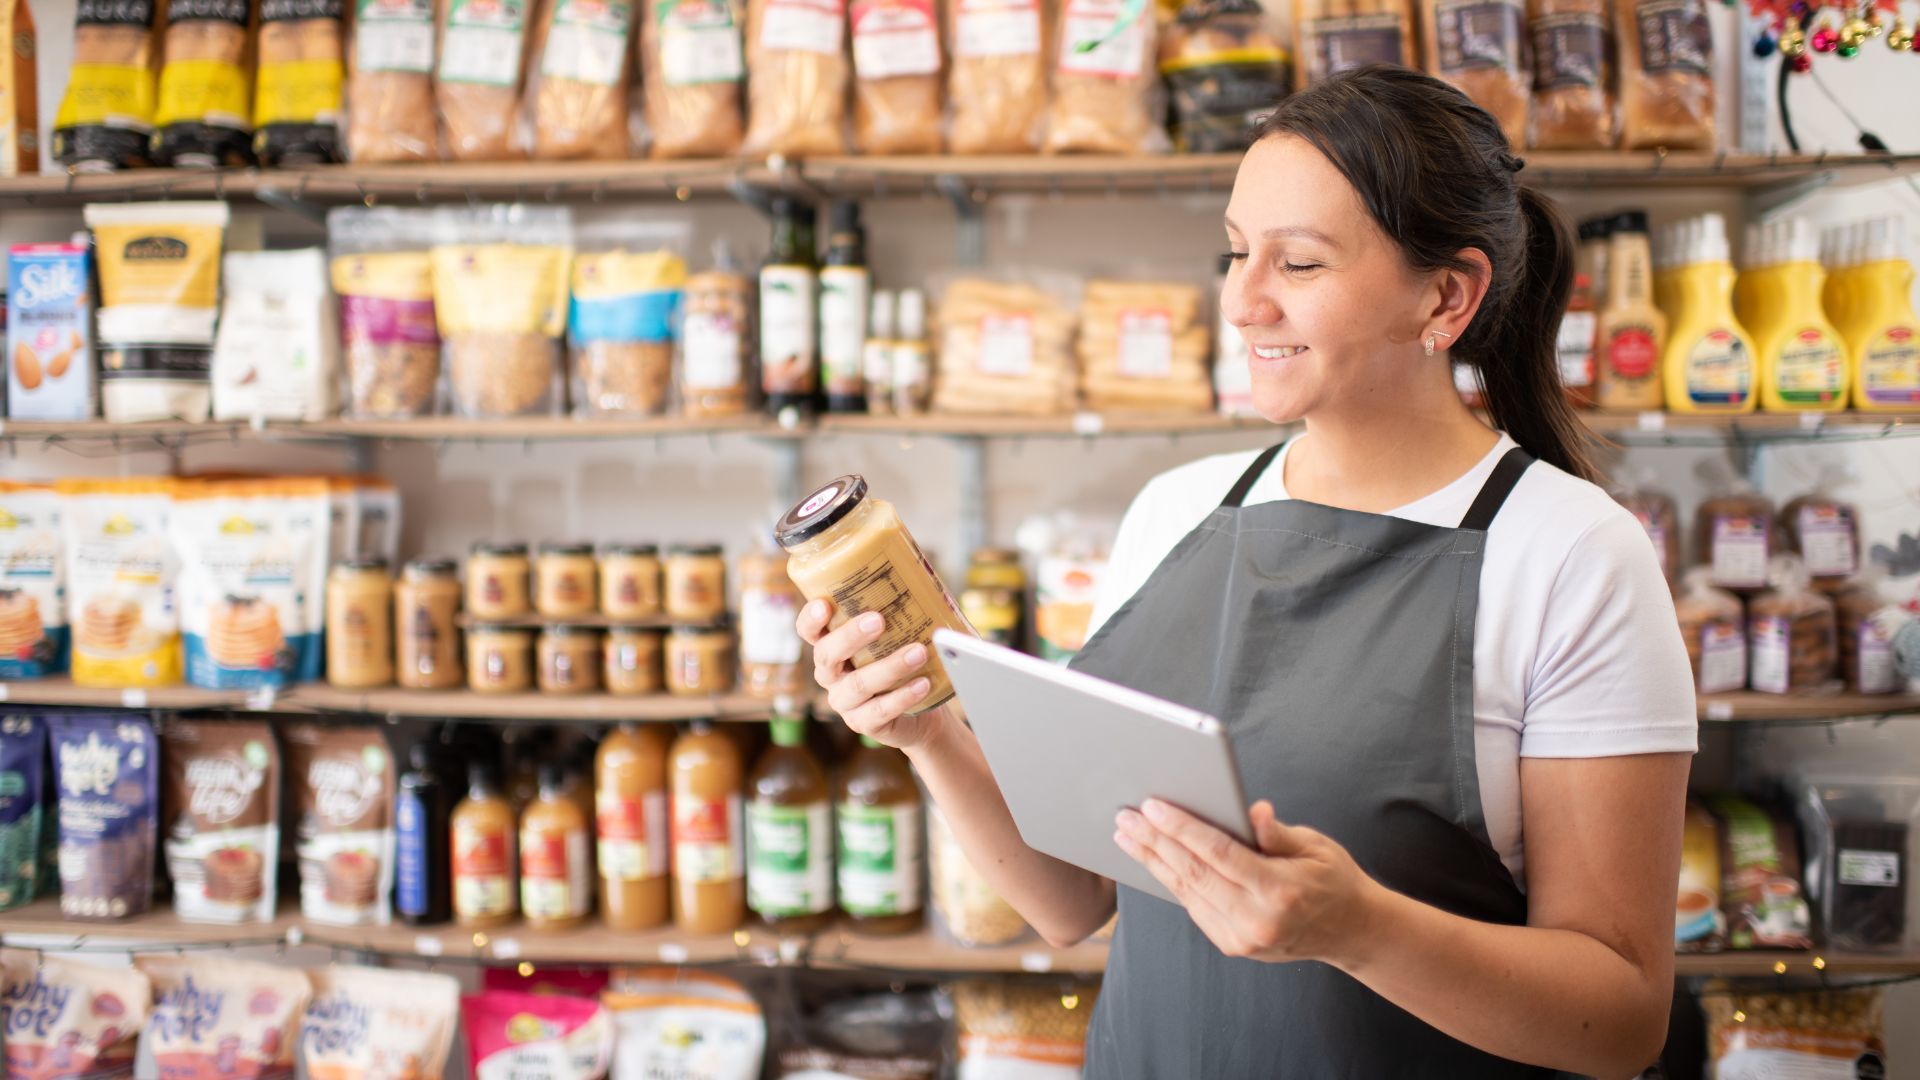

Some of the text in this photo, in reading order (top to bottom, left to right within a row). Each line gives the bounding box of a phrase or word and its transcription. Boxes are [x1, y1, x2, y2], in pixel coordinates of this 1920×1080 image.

[16, 261, 80, 308] Silk
[0, 972, 71, 1025] why
[152, 975, 224, 1031] why
[305, 990, 368, 1046] why
[149, 1013, 204, 1043] not
[304, 1024, 354, 1056] not
